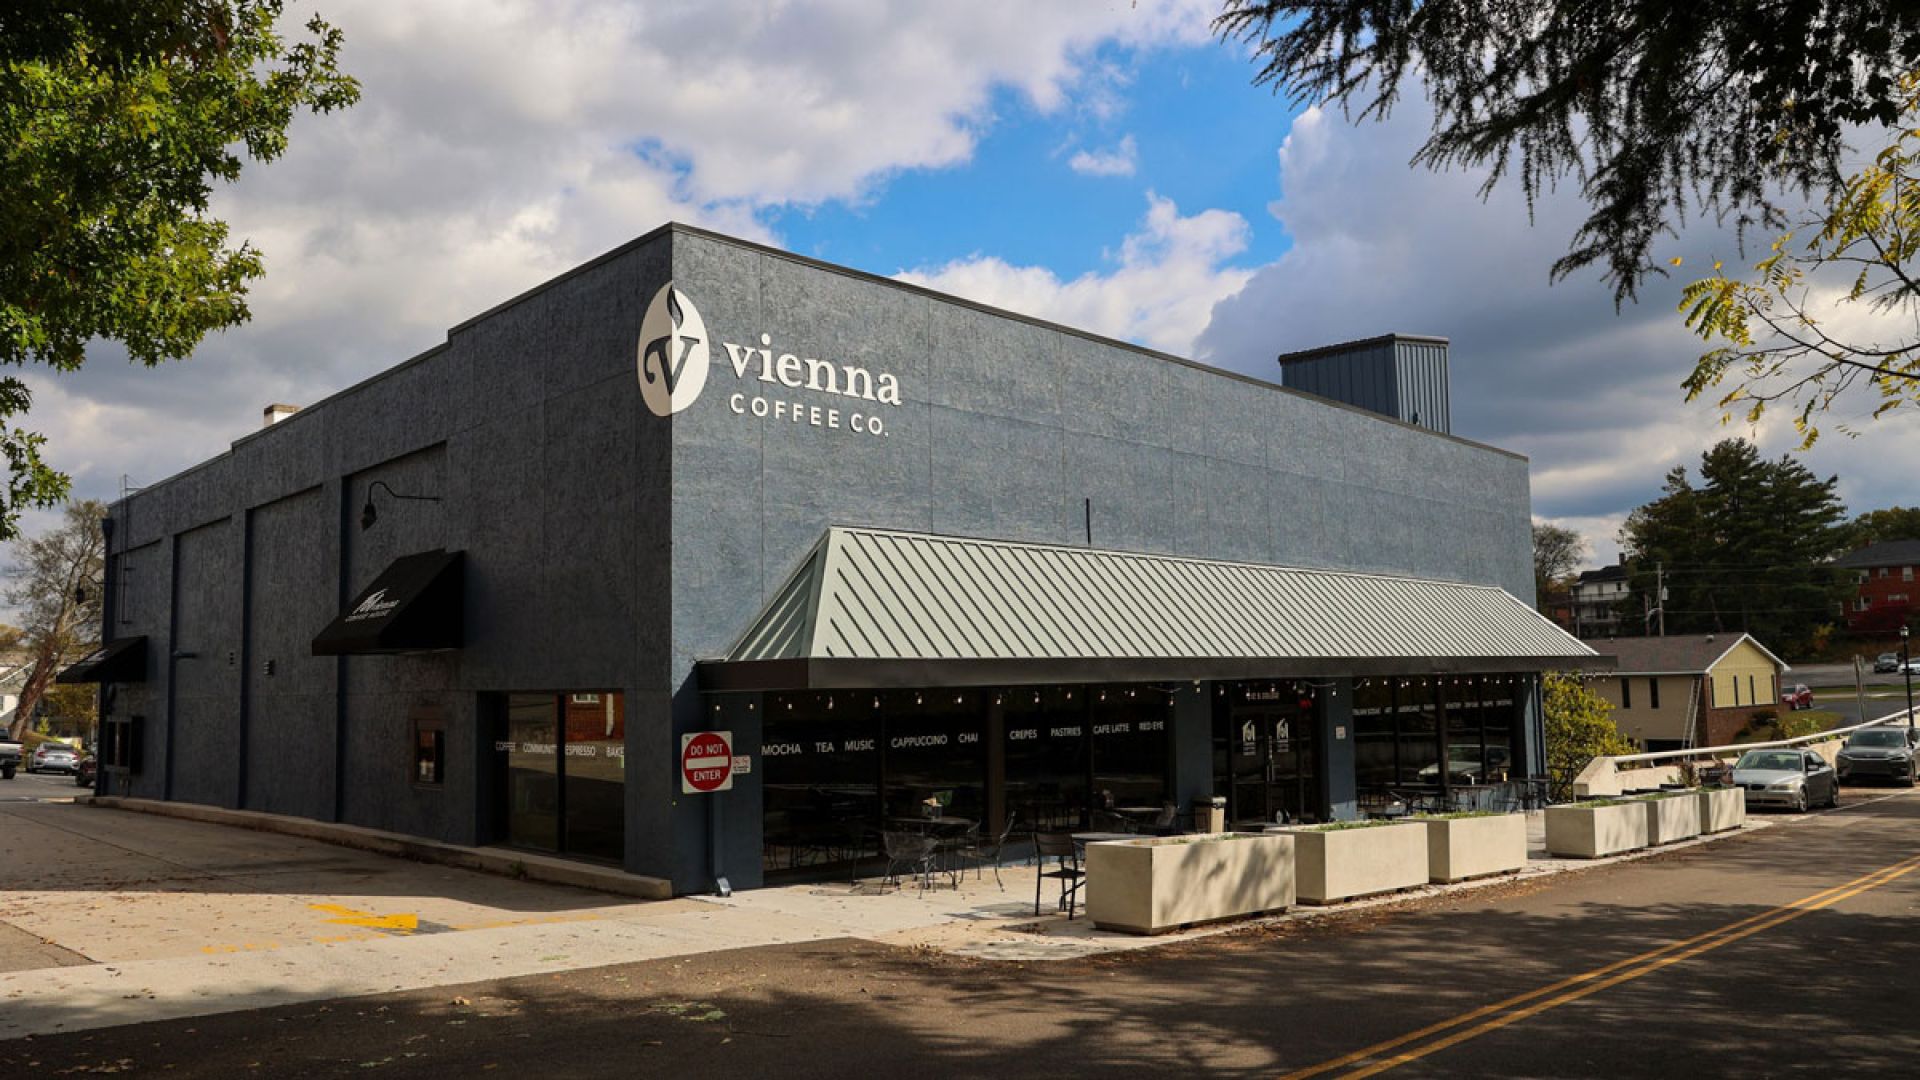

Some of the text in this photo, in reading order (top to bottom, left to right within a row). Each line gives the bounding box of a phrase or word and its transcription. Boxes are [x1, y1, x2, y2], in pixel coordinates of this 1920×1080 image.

[723, 333, 902, 405] vienna
[730, 393, 889, 437] COFFEE CO.
[891, 733, 979, 748] CAPPUCCINO CHAI
[1009, 726, 1082, 740] CREPES PASTRIES
[690, 744, 724, 755] DO NOT
[761, 740, 875, 756] MOCHA TEA MUSIC
[693, 770, 721, 782] ENTER
